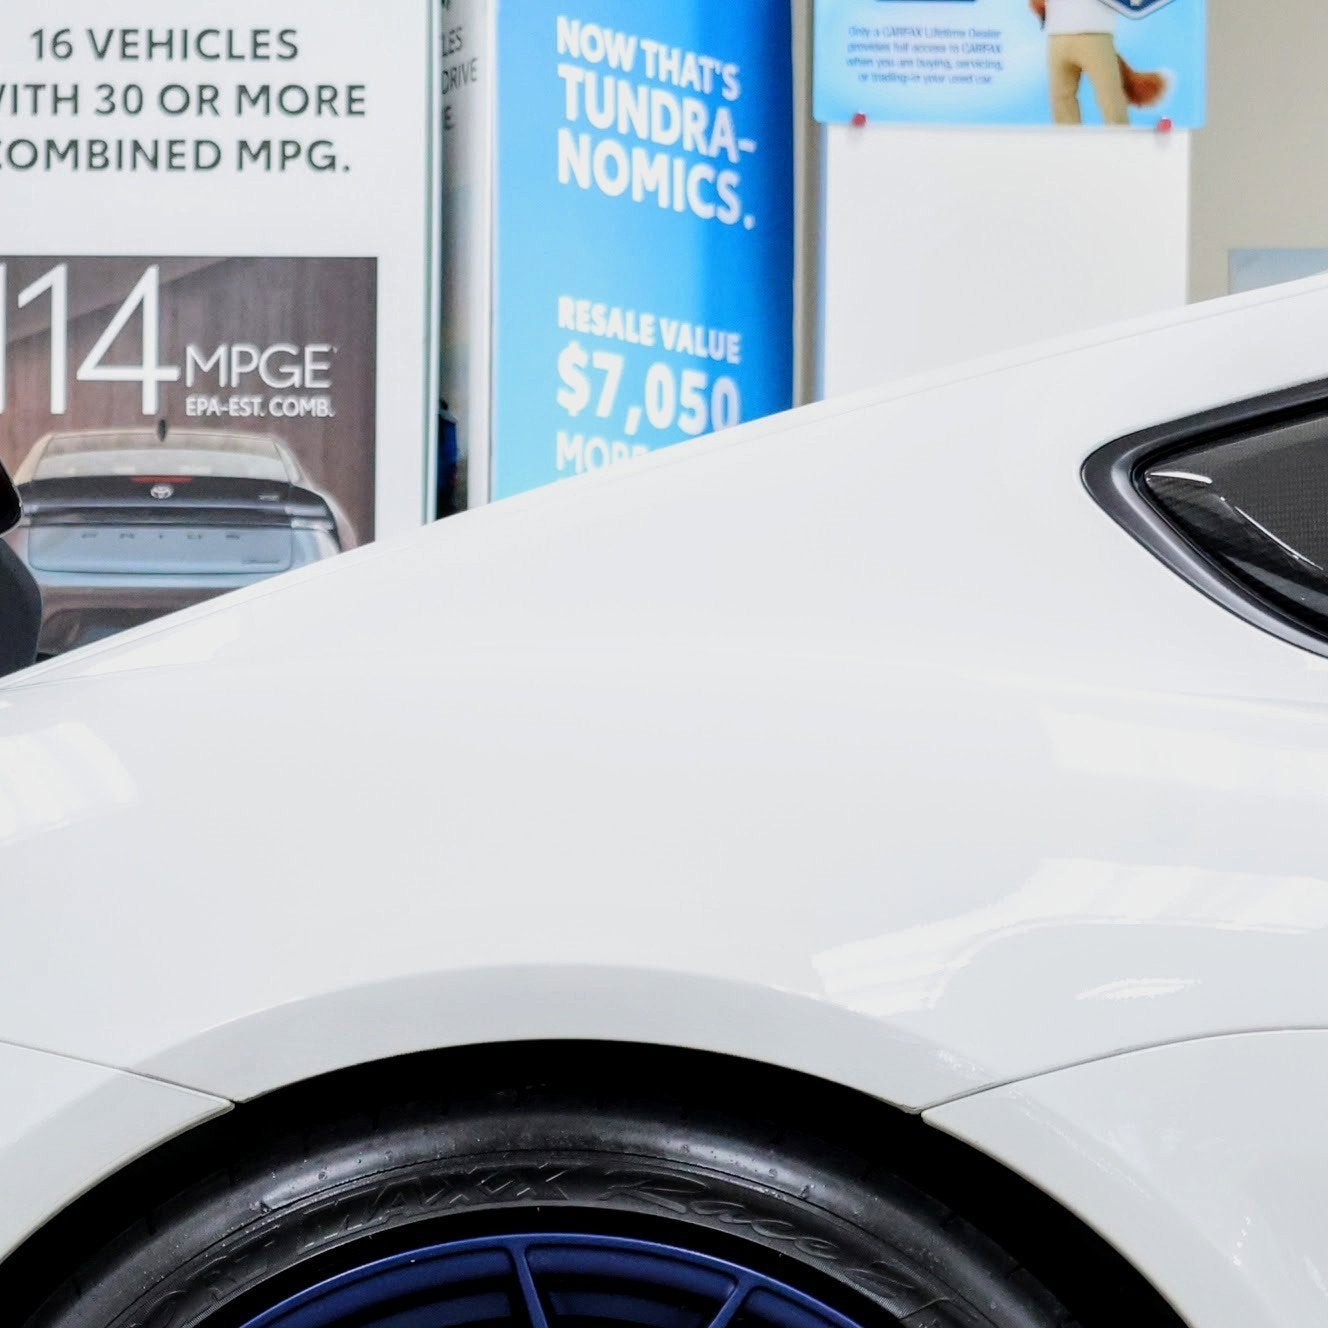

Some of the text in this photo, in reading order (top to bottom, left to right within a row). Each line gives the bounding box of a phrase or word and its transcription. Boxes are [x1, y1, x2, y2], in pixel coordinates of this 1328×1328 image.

[30, 28, 298, 60] 16 VEHICLES
[557, 15, 742, 101] NOW THAT'S
[95, 83, 143, 116] 30
[159, 83, 220, 116] OR
[236, 83, 366, 116] MORE
[557, 63, 757, 164] TUNDRA-
[236, 139, 350, 172] MPG.
[557, 127, 756, 230] NOMICS.
[557, 296, 742, 365] RESALE VALUE
[185, 394, 335, 417] EPA-EST. COMB.
[556, 340, 741, 435] $7,050
